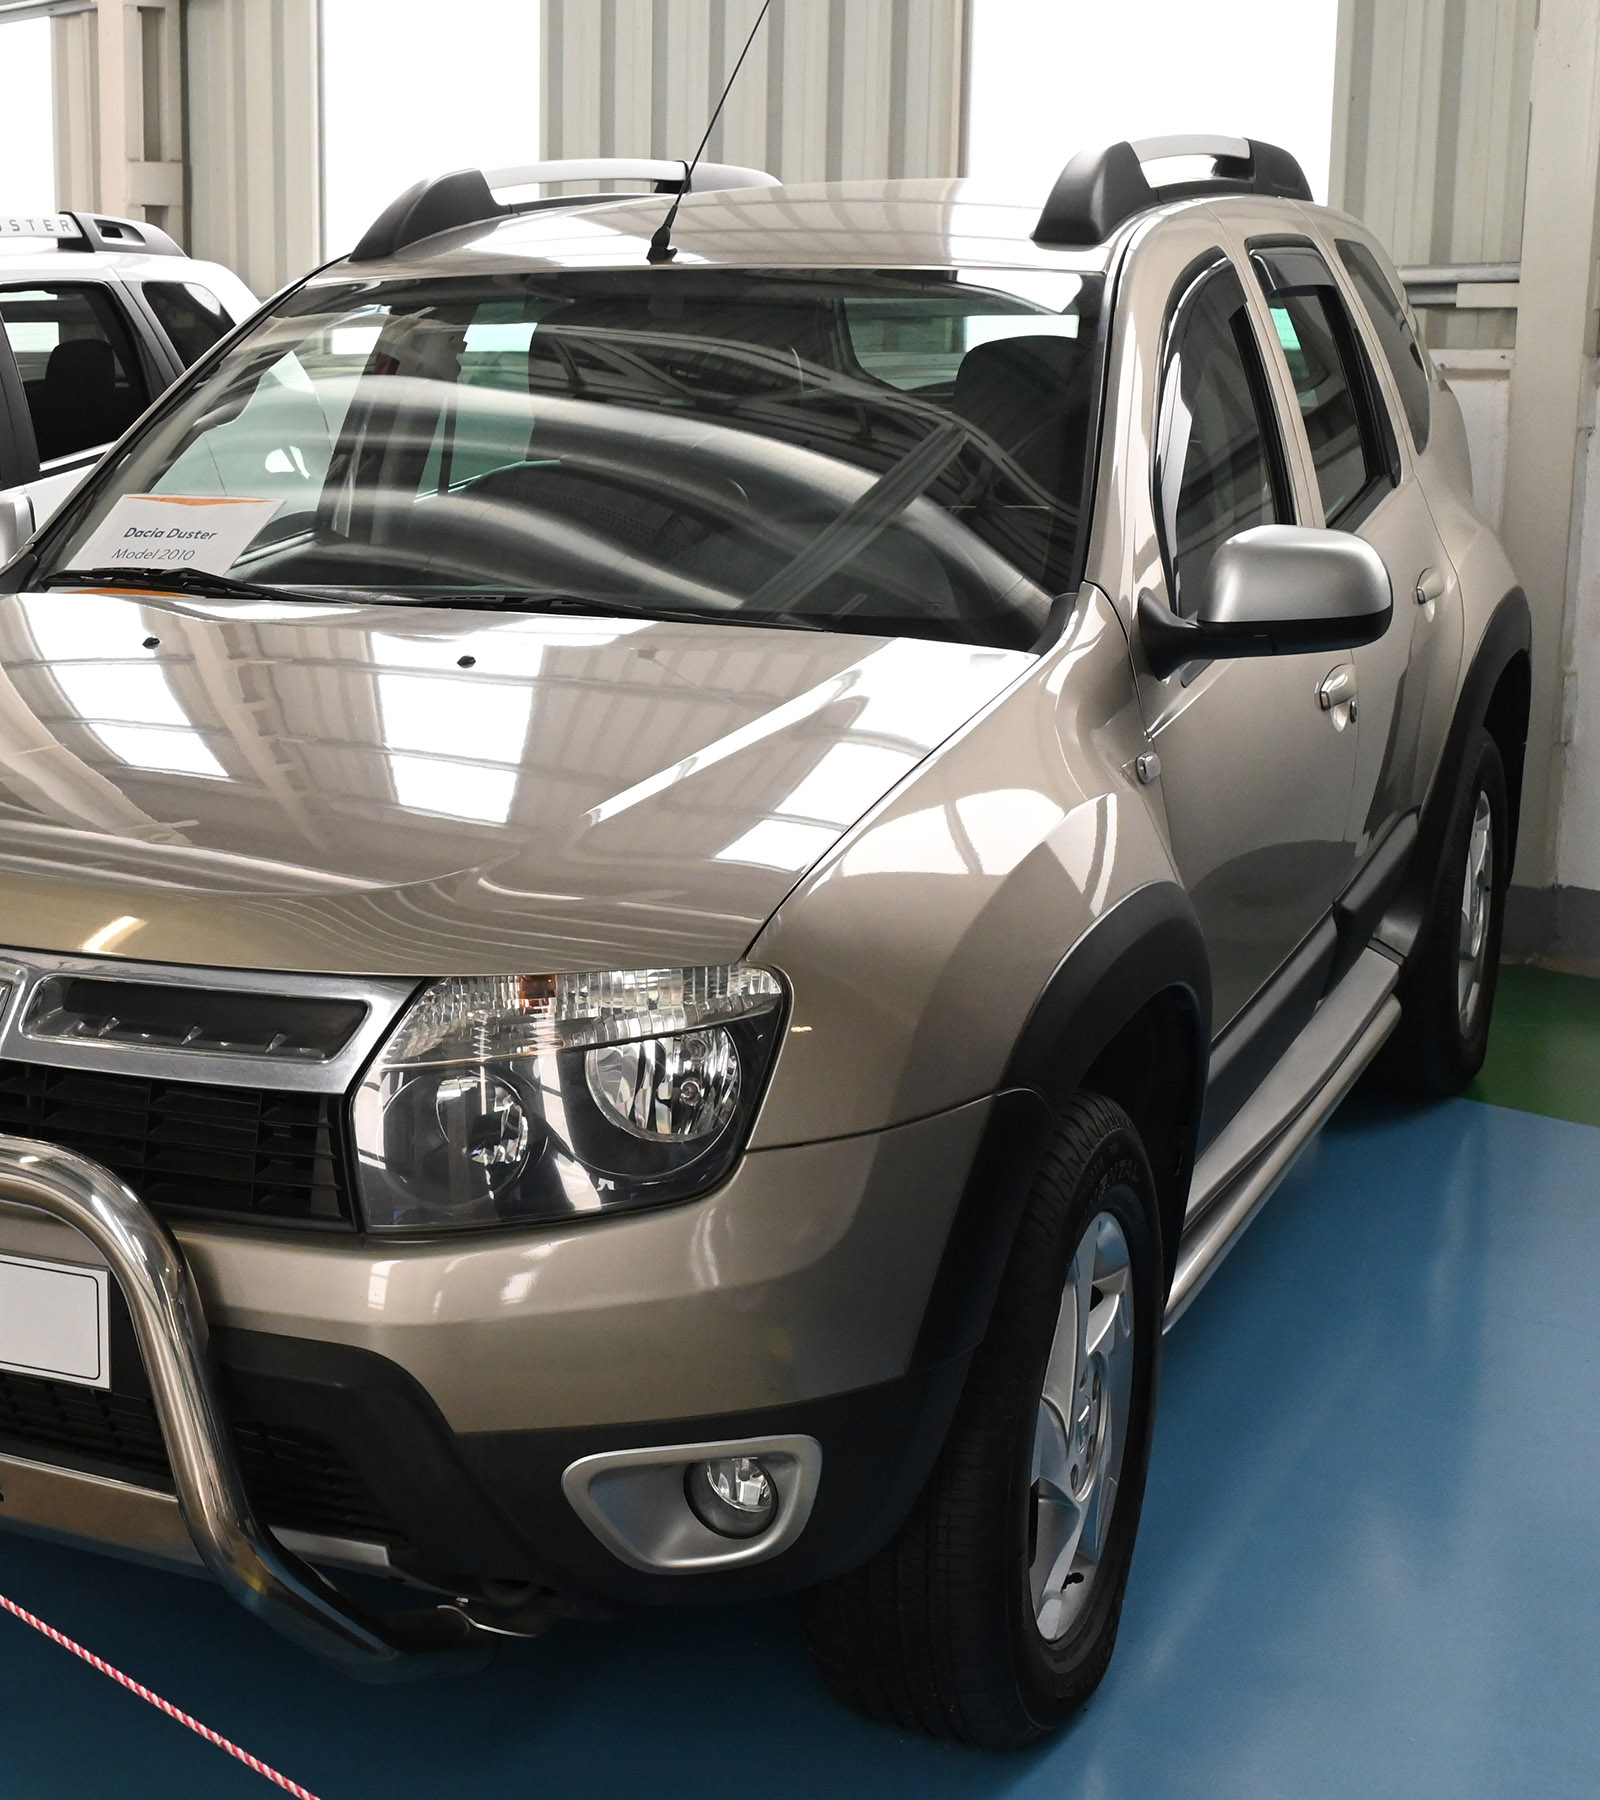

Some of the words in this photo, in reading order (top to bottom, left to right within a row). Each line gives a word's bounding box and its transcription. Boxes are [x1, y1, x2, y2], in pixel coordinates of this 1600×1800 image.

[124, 527, 164, 539] Dacia
[166, 528, 217, 540] Duster
[111, 548, 159, 560] Model
[158, 549, 196, 561] 2010
